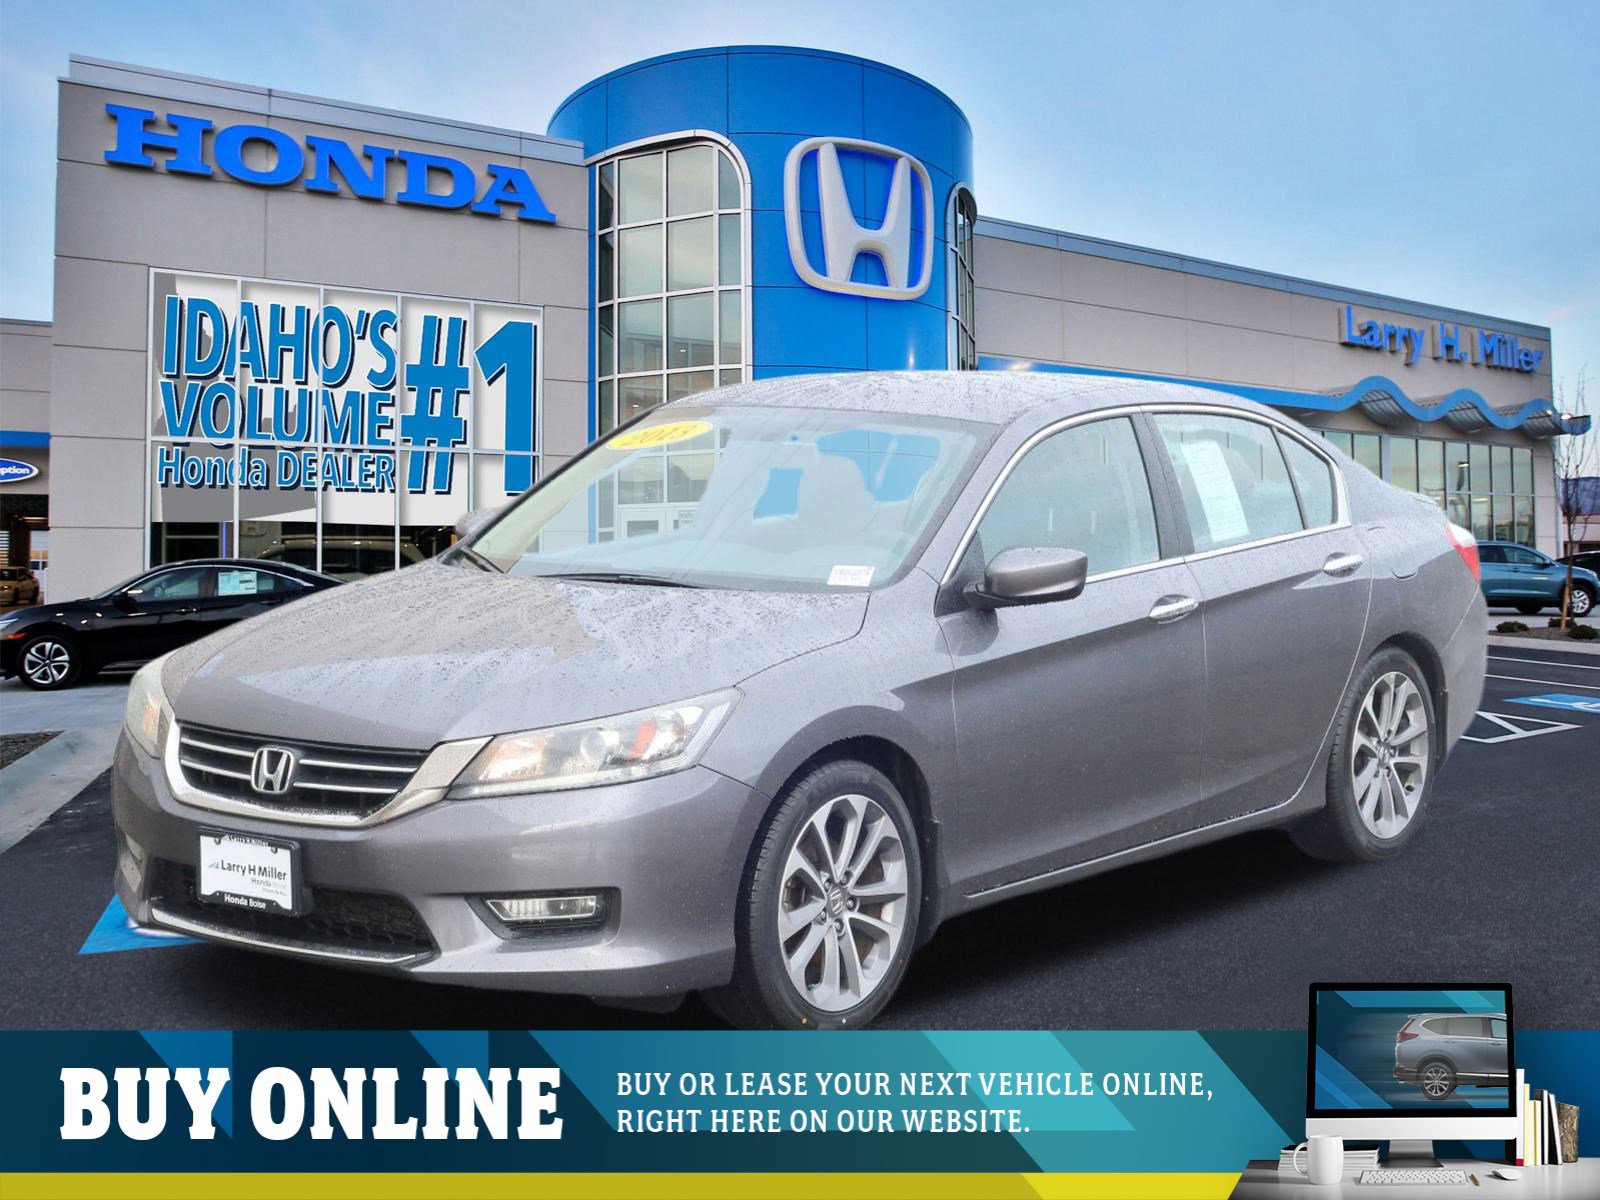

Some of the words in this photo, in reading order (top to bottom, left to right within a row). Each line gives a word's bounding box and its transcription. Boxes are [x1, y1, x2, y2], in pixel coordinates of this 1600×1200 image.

[104, 103, 557, 224] HONDA
[162, 295, 398, 391] IDAHO'S
[1341, 305, 1424, 366] Larry
[1434, 323, 1468, 362] H.
[1474, 329, 1544, 372] Miller
[159, 380, 397, 453] VOLUME
[400, 315, 538, 496] #1
[157, 446, 269, 491] Honda
[276, 450, 396, 494] DEALER
[221, 859, 246, 876] Larry
[248, 864, 256, 875] H
[258, 866, 287, 880] Miller
[224, 893, 248, 906] Honda
[249, 899, 266, 909] Boise
[251, 878, 271, 887] Honda
